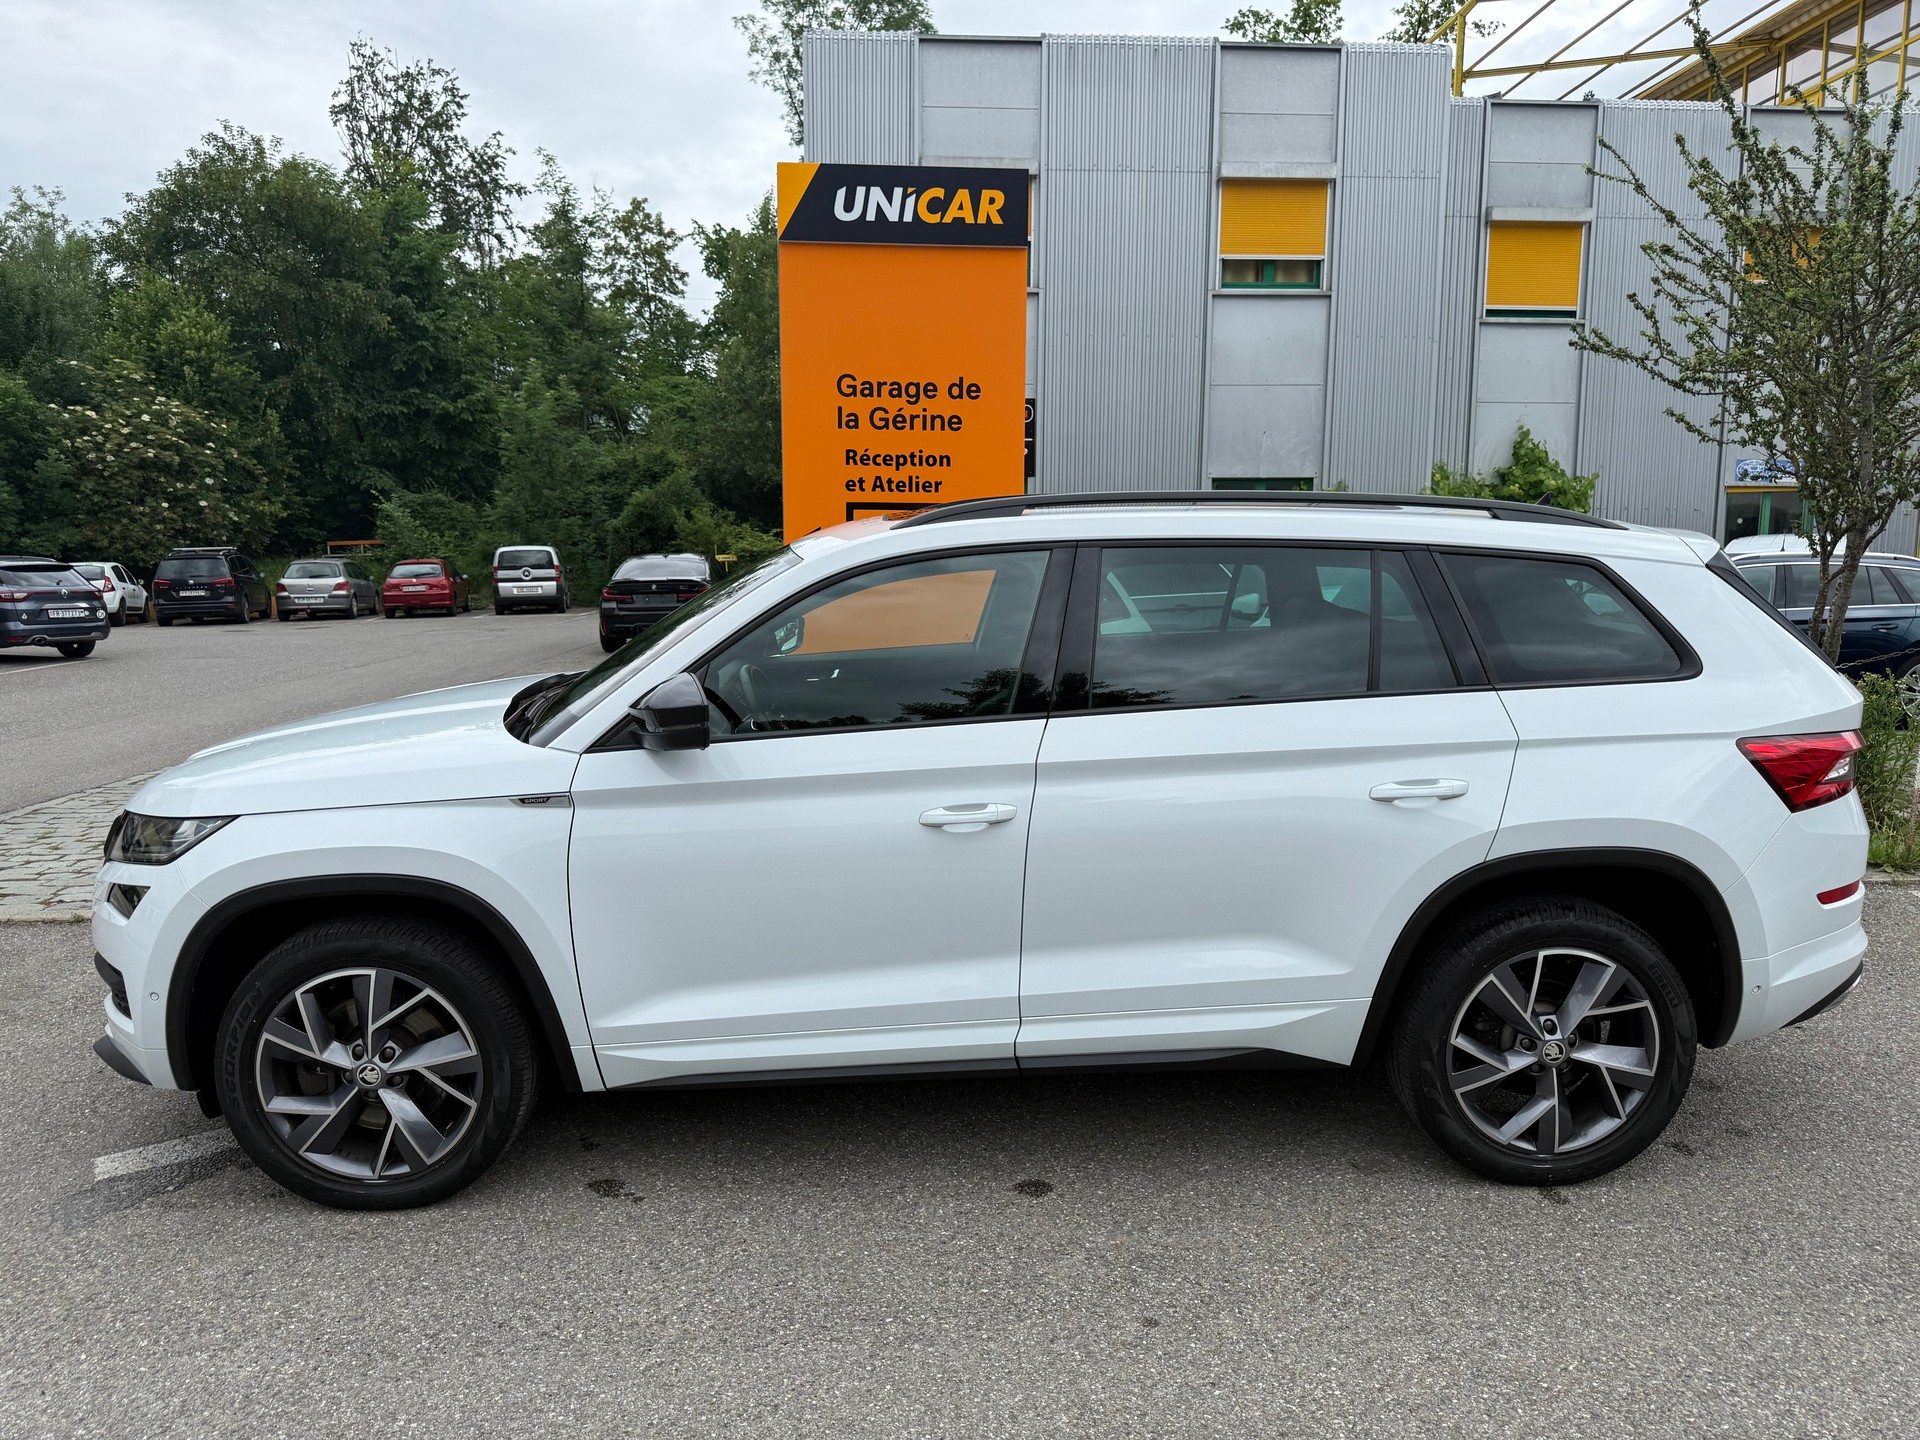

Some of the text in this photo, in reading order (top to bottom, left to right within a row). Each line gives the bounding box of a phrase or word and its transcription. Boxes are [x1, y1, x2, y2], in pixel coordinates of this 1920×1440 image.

[836, 373, 981, 405] Garage de
[837, 406, 963, 432] la Gérine
[845, 448, 951, 471] Réception
[845, 475, 942, 493] et Atelier
